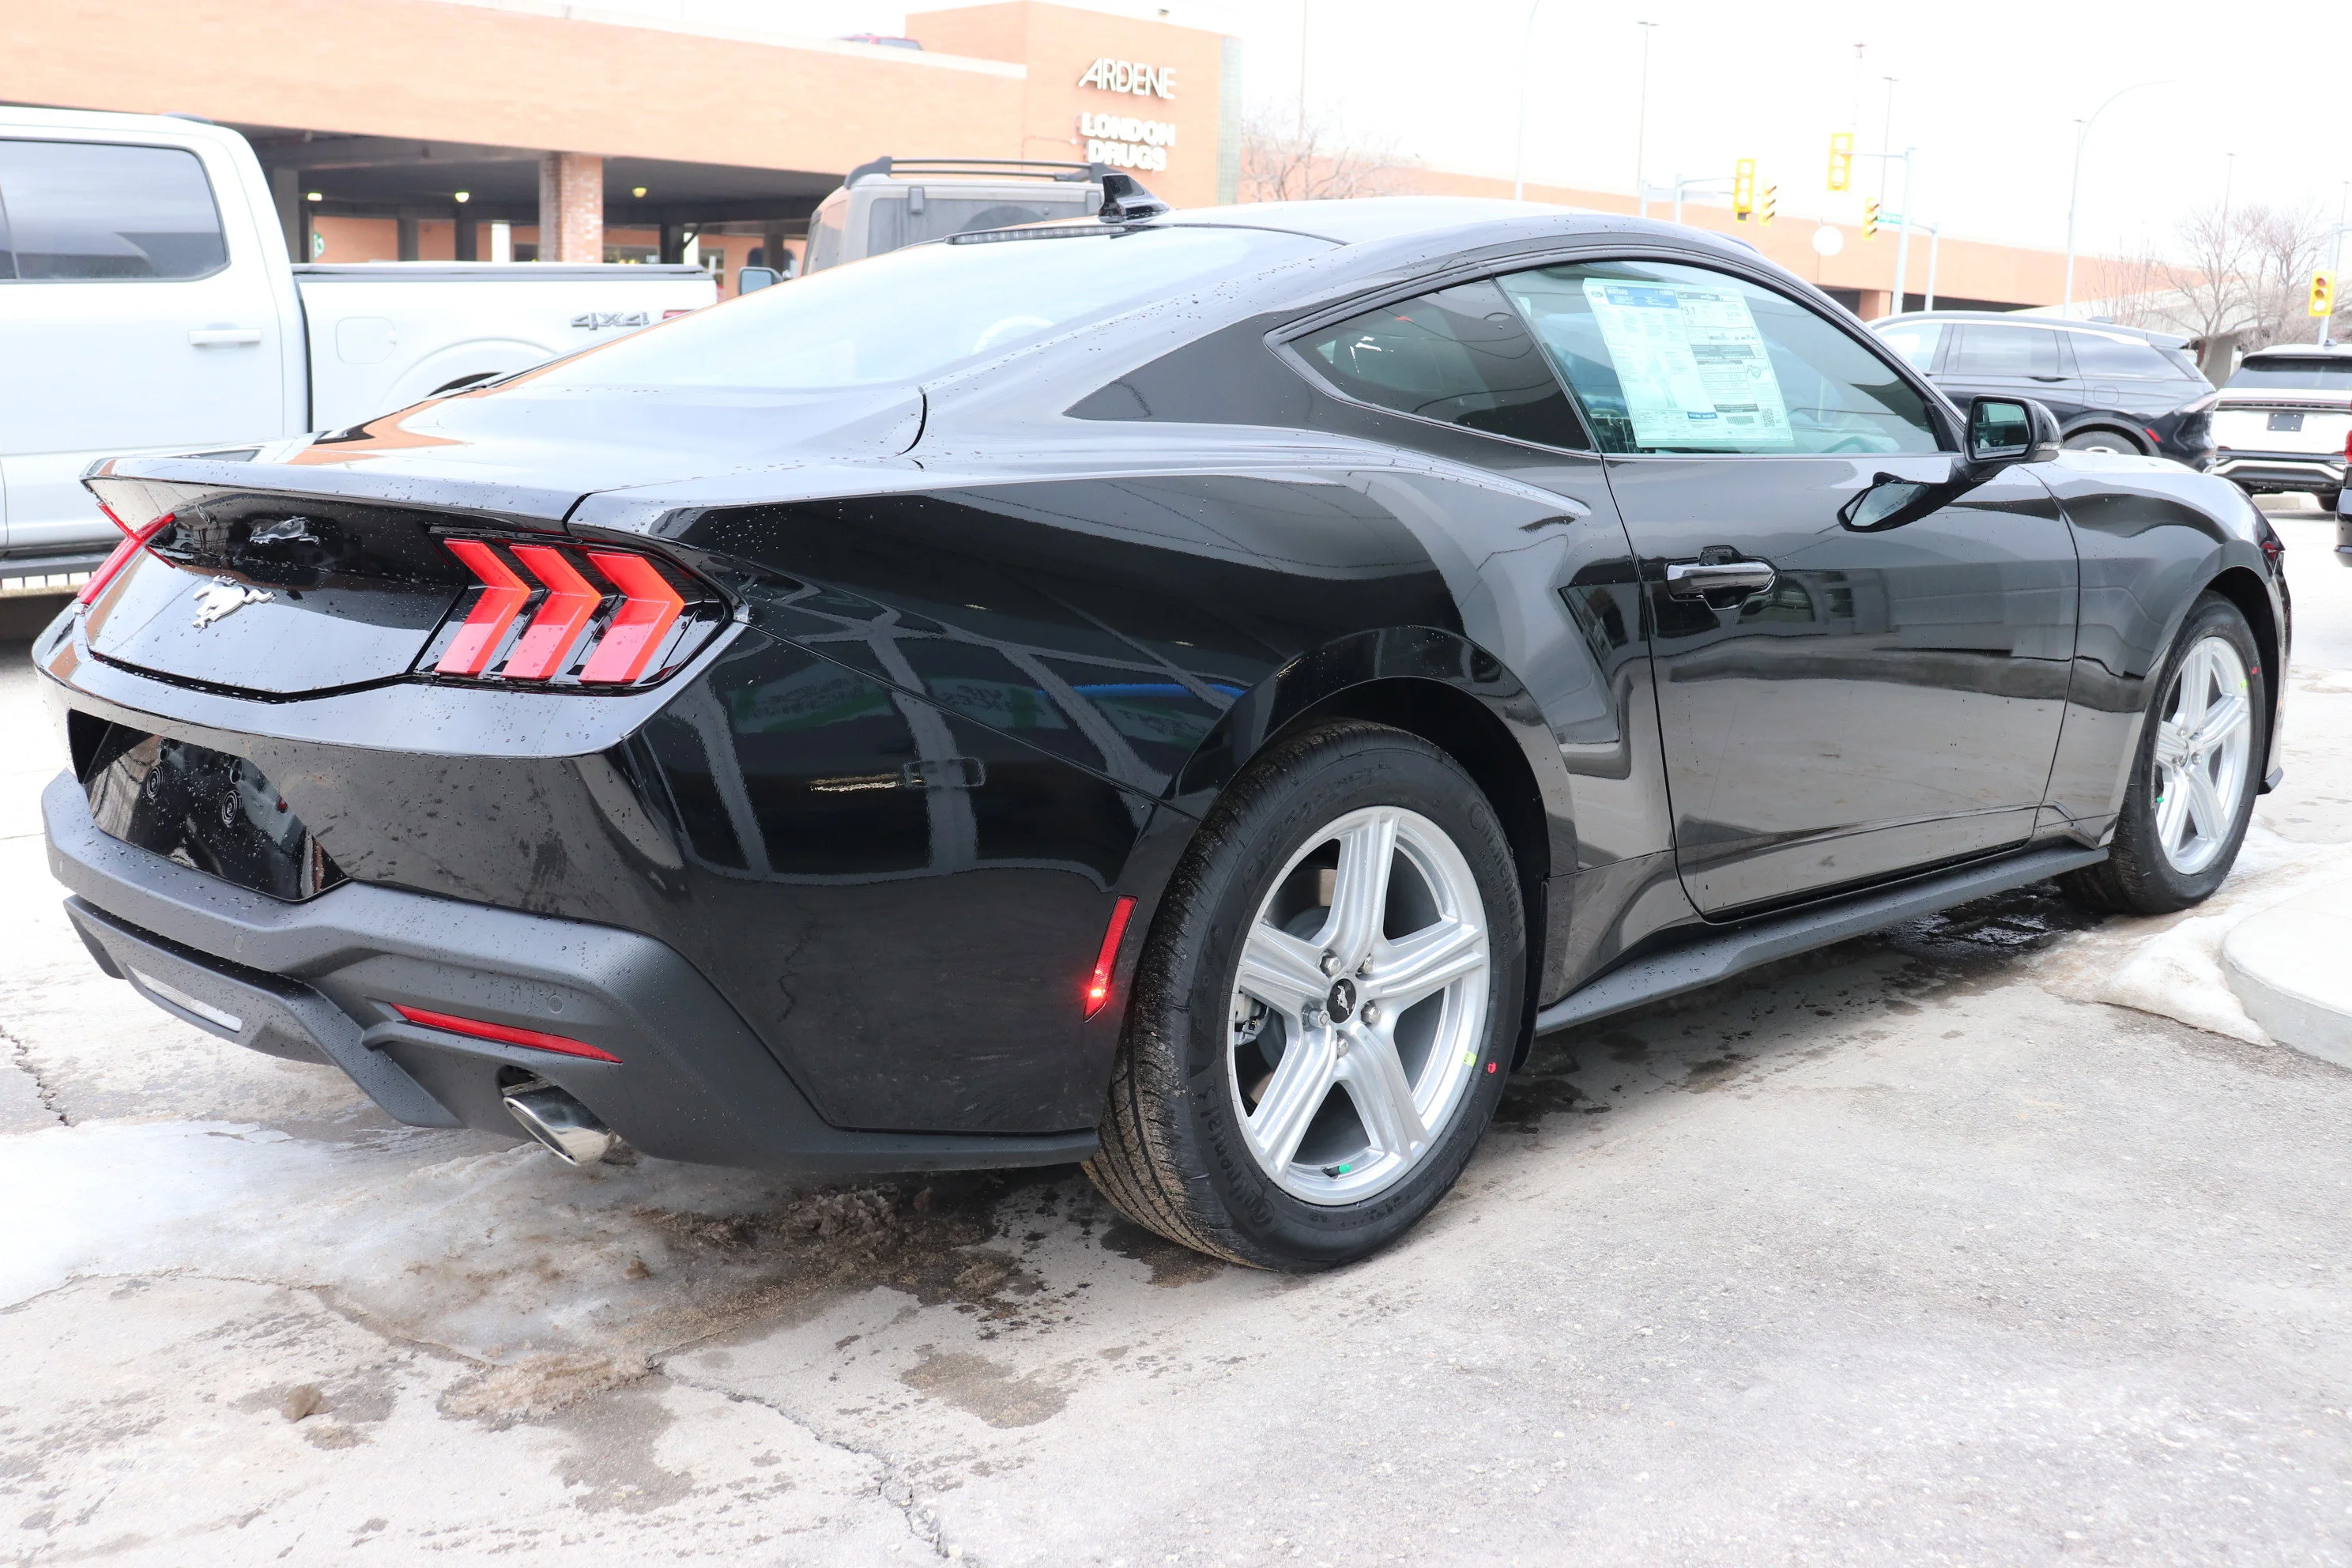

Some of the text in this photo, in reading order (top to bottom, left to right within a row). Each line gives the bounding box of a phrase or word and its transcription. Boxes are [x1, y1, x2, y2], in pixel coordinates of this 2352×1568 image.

[1077, 58, 1176, 100] ARDENE
[1080, 112, 1176, 146] LONDON
[1087, 139, 1167, 171] DRUGS
